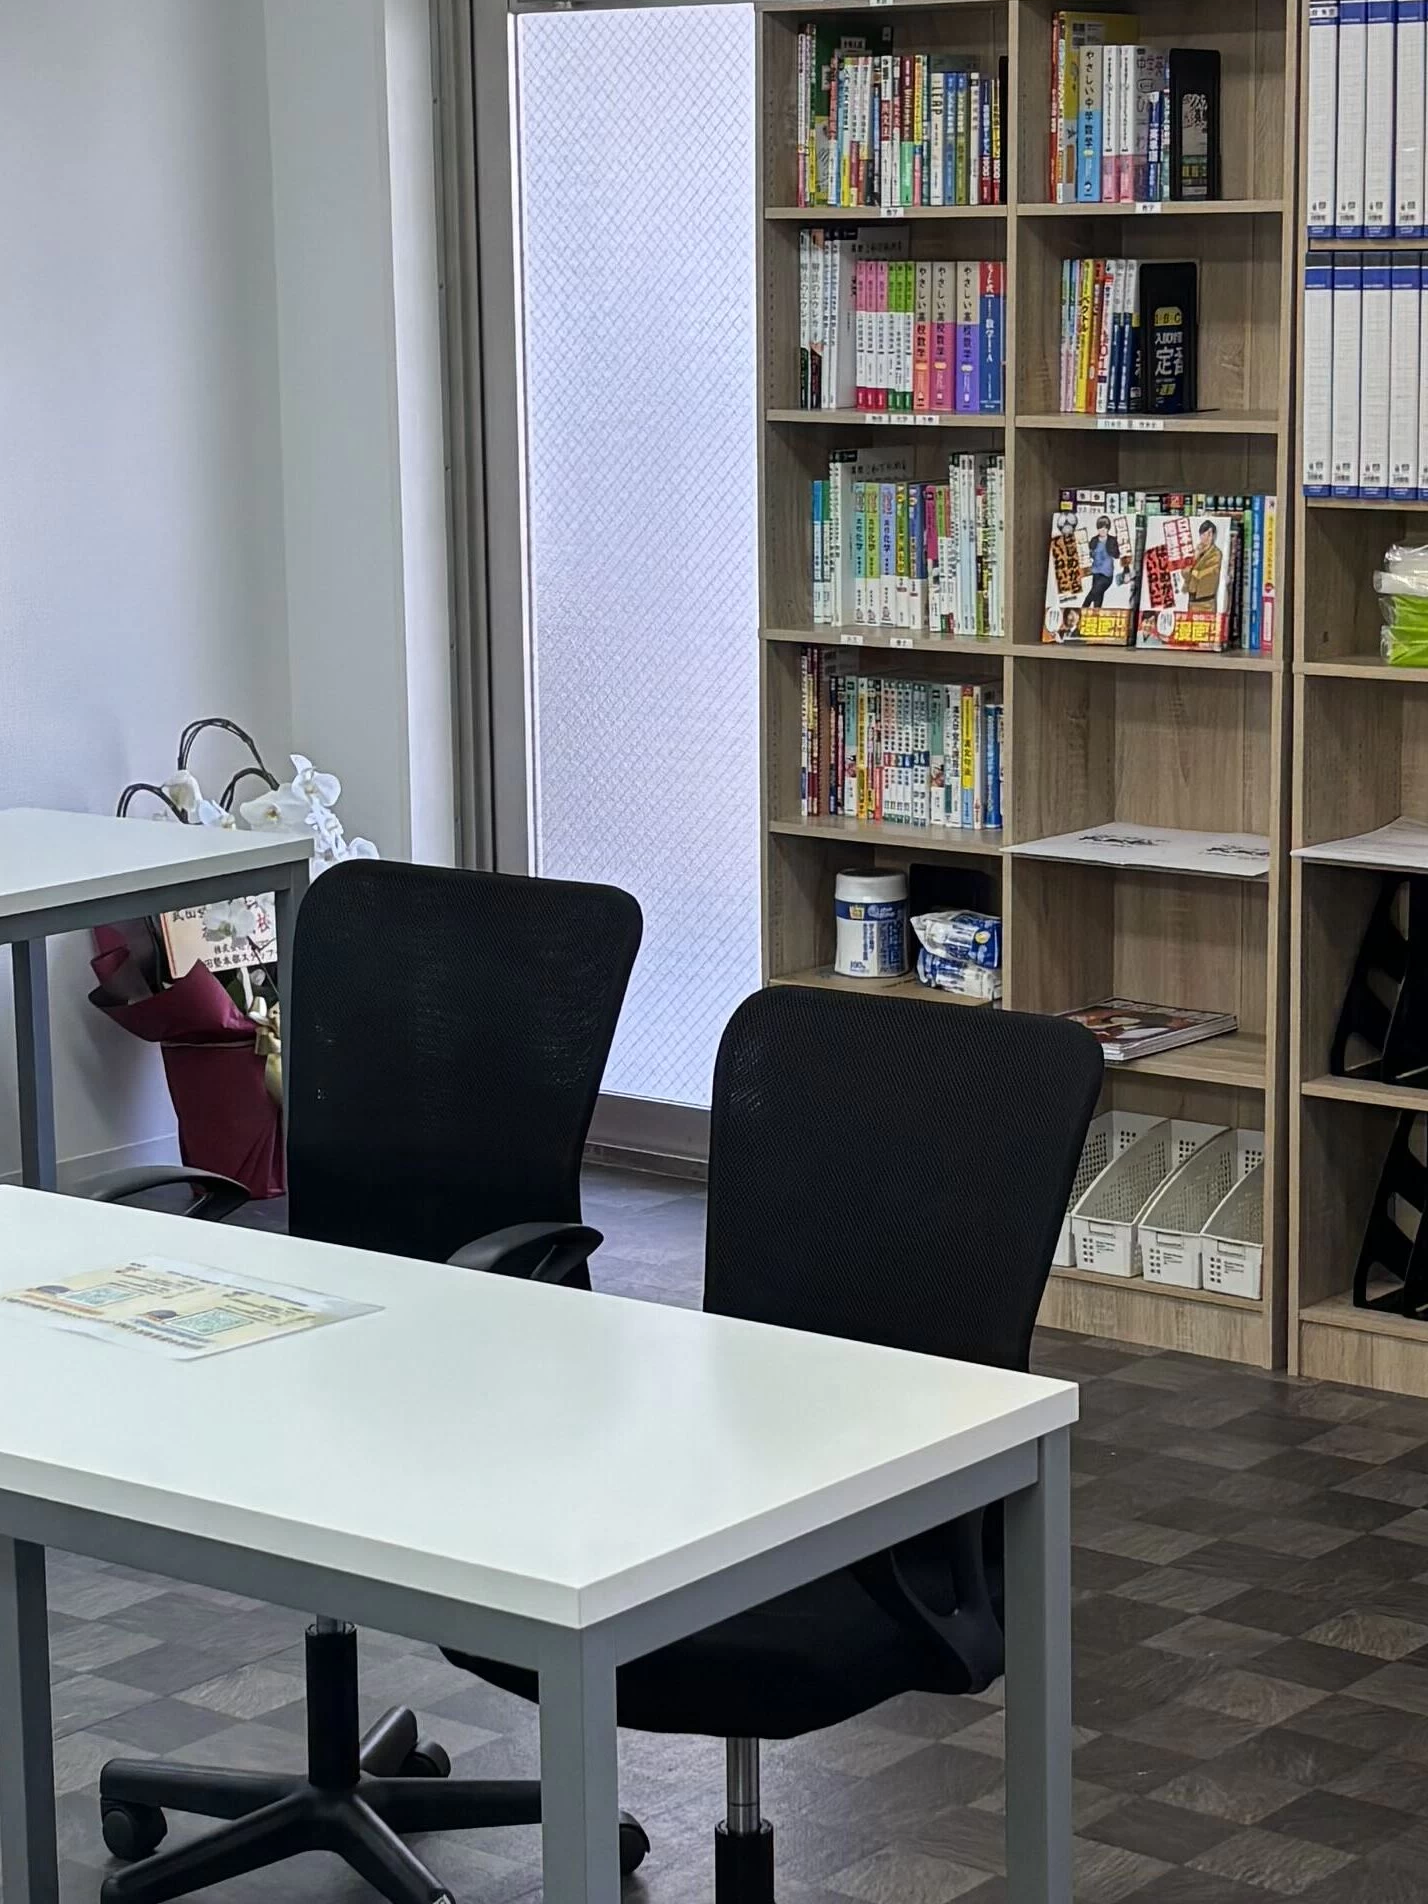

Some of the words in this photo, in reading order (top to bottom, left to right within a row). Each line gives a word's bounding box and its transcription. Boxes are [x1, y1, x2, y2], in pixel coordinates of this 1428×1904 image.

[1085, 51, 1095, 148] やさしい中学数学
